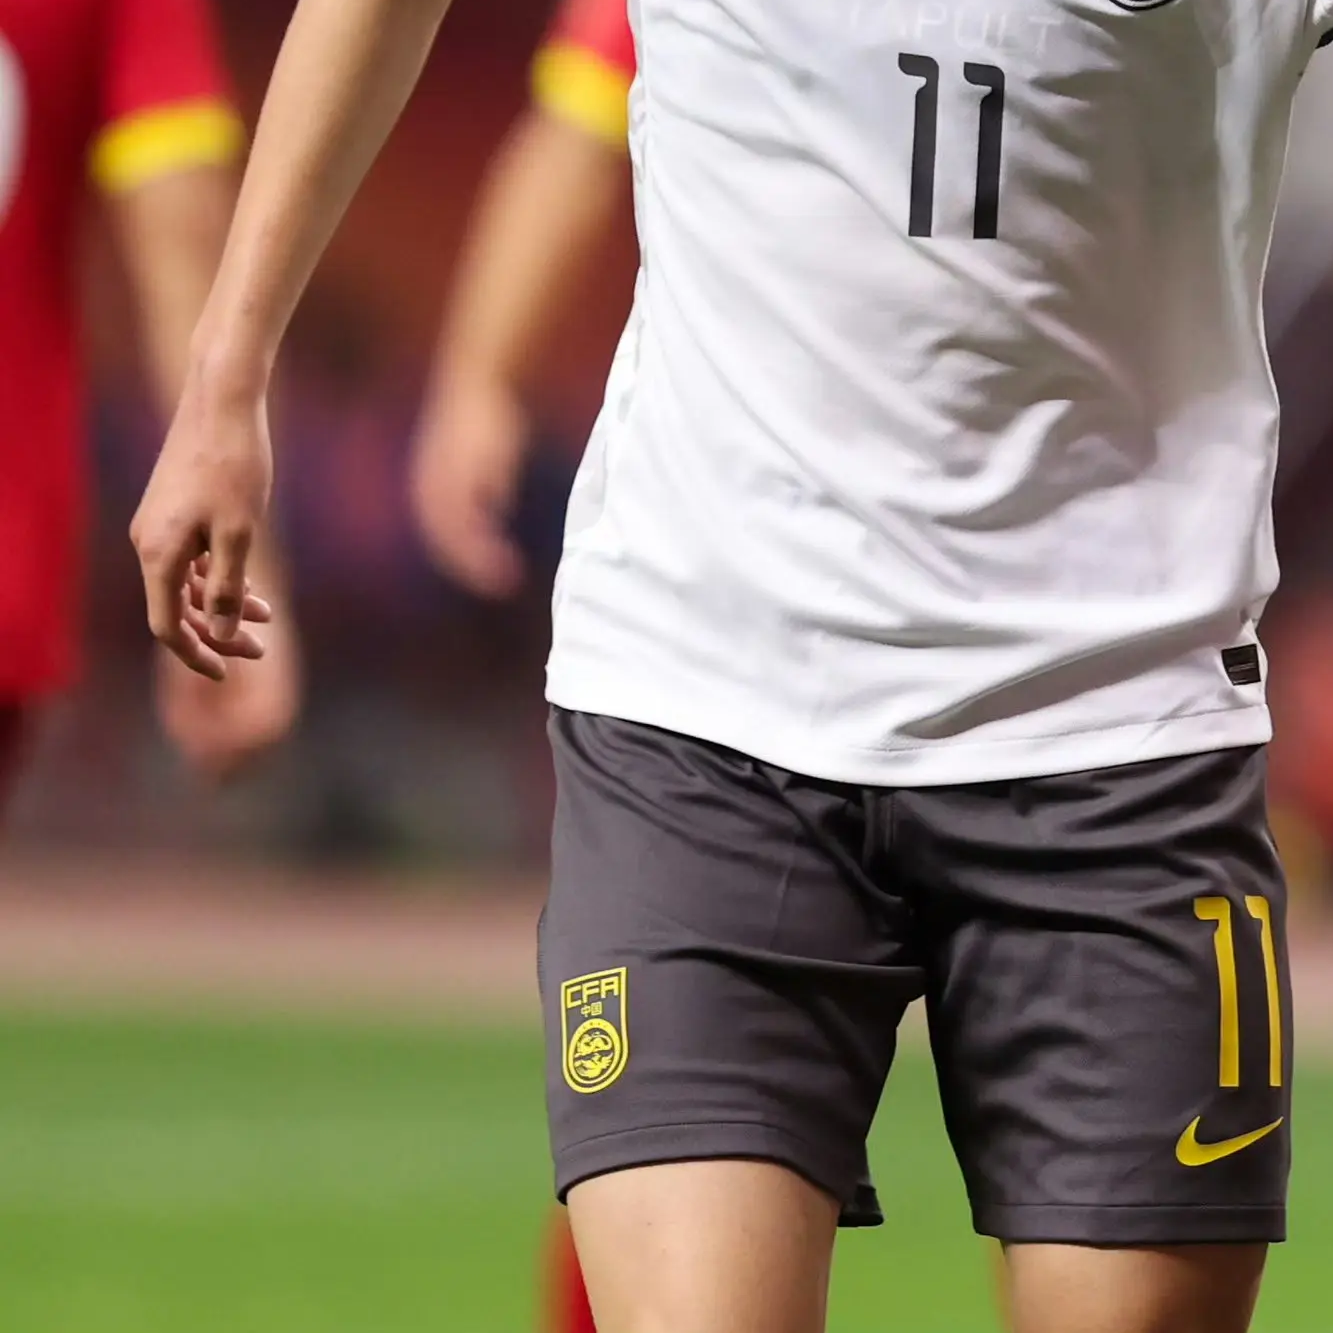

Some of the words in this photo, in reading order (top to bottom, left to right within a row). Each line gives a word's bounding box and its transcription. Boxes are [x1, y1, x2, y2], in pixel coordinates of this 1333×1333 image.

[898, 53, 1005, 239] 11
[566, 976, 620, 1008] CFA
[1194, 895, 1281, 1087] 11
